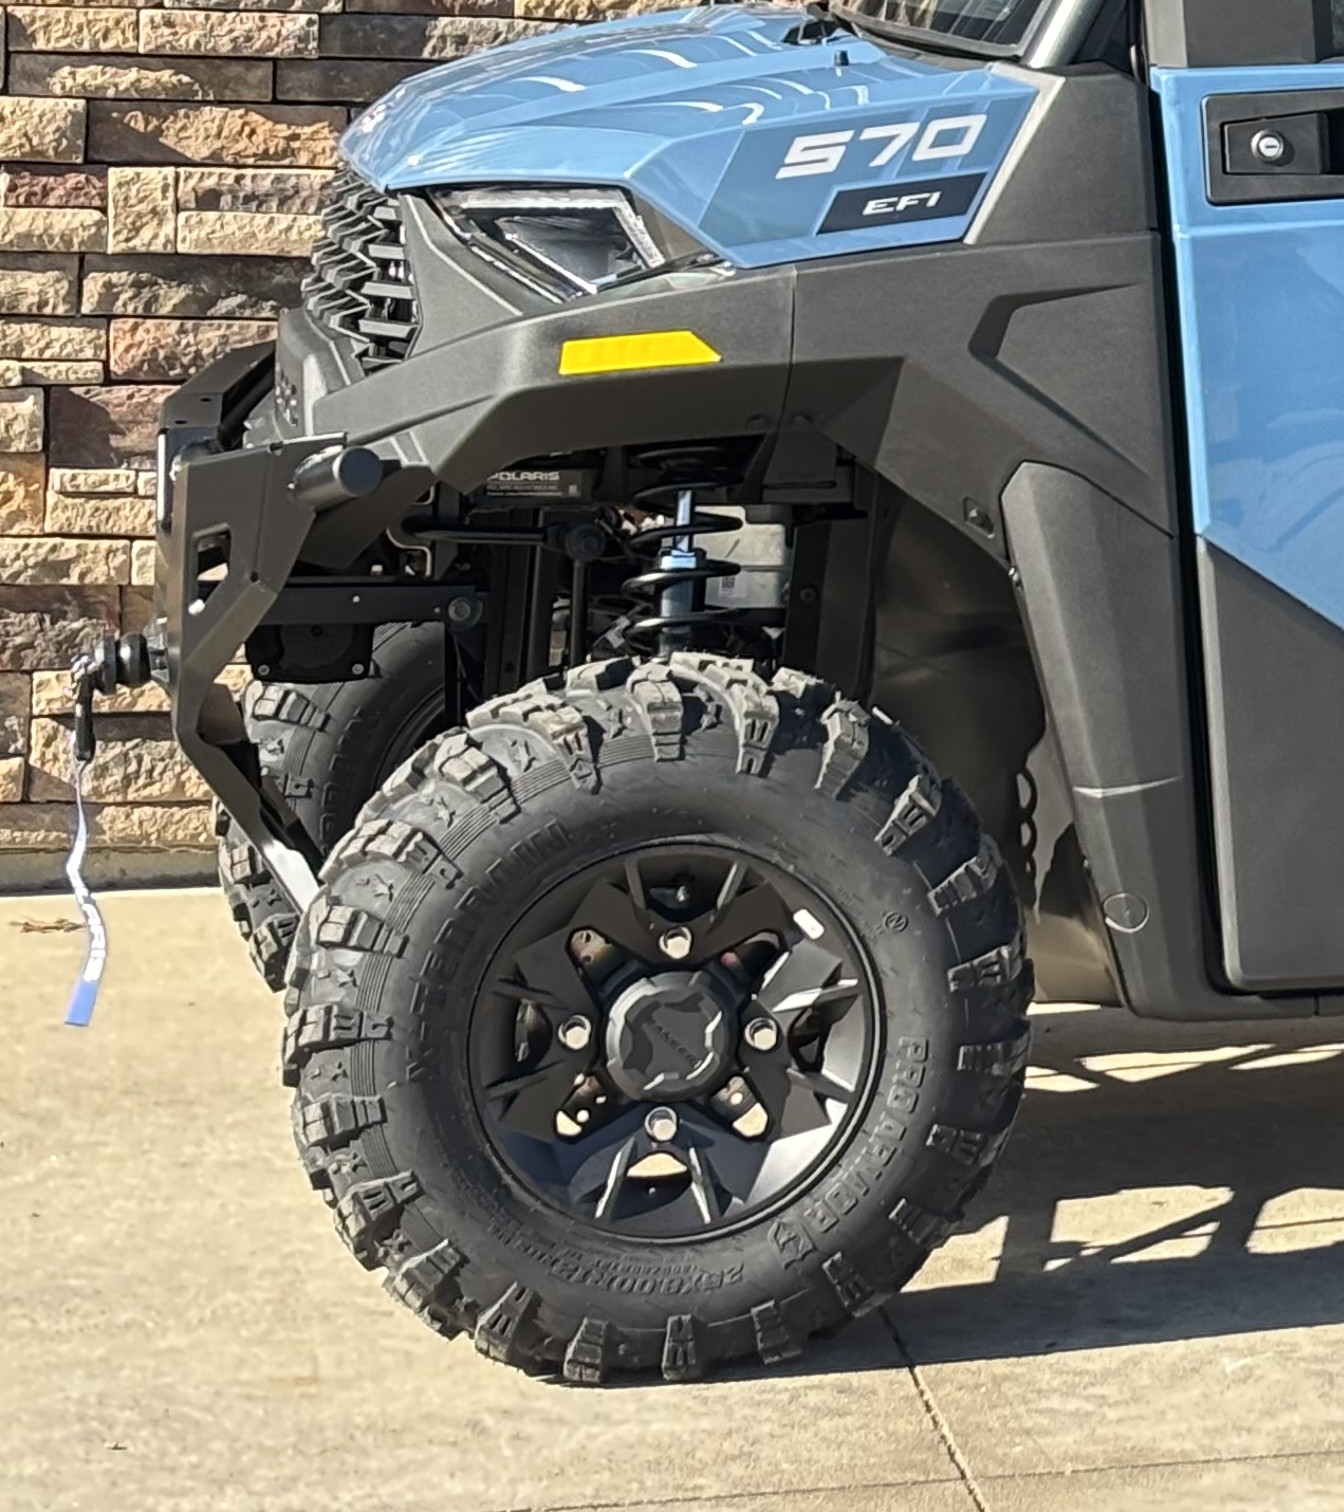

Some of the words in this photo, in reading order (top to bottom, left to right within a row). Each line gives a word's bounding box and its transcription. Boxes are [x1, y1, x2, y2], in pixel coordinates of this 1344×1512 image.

[775, 113, 988, 180] 570
[861, 190, 942, 217] EFI
[886, 1034, 930, 1115] PRO
[802, 1110, 908, 1234] ARMOR
